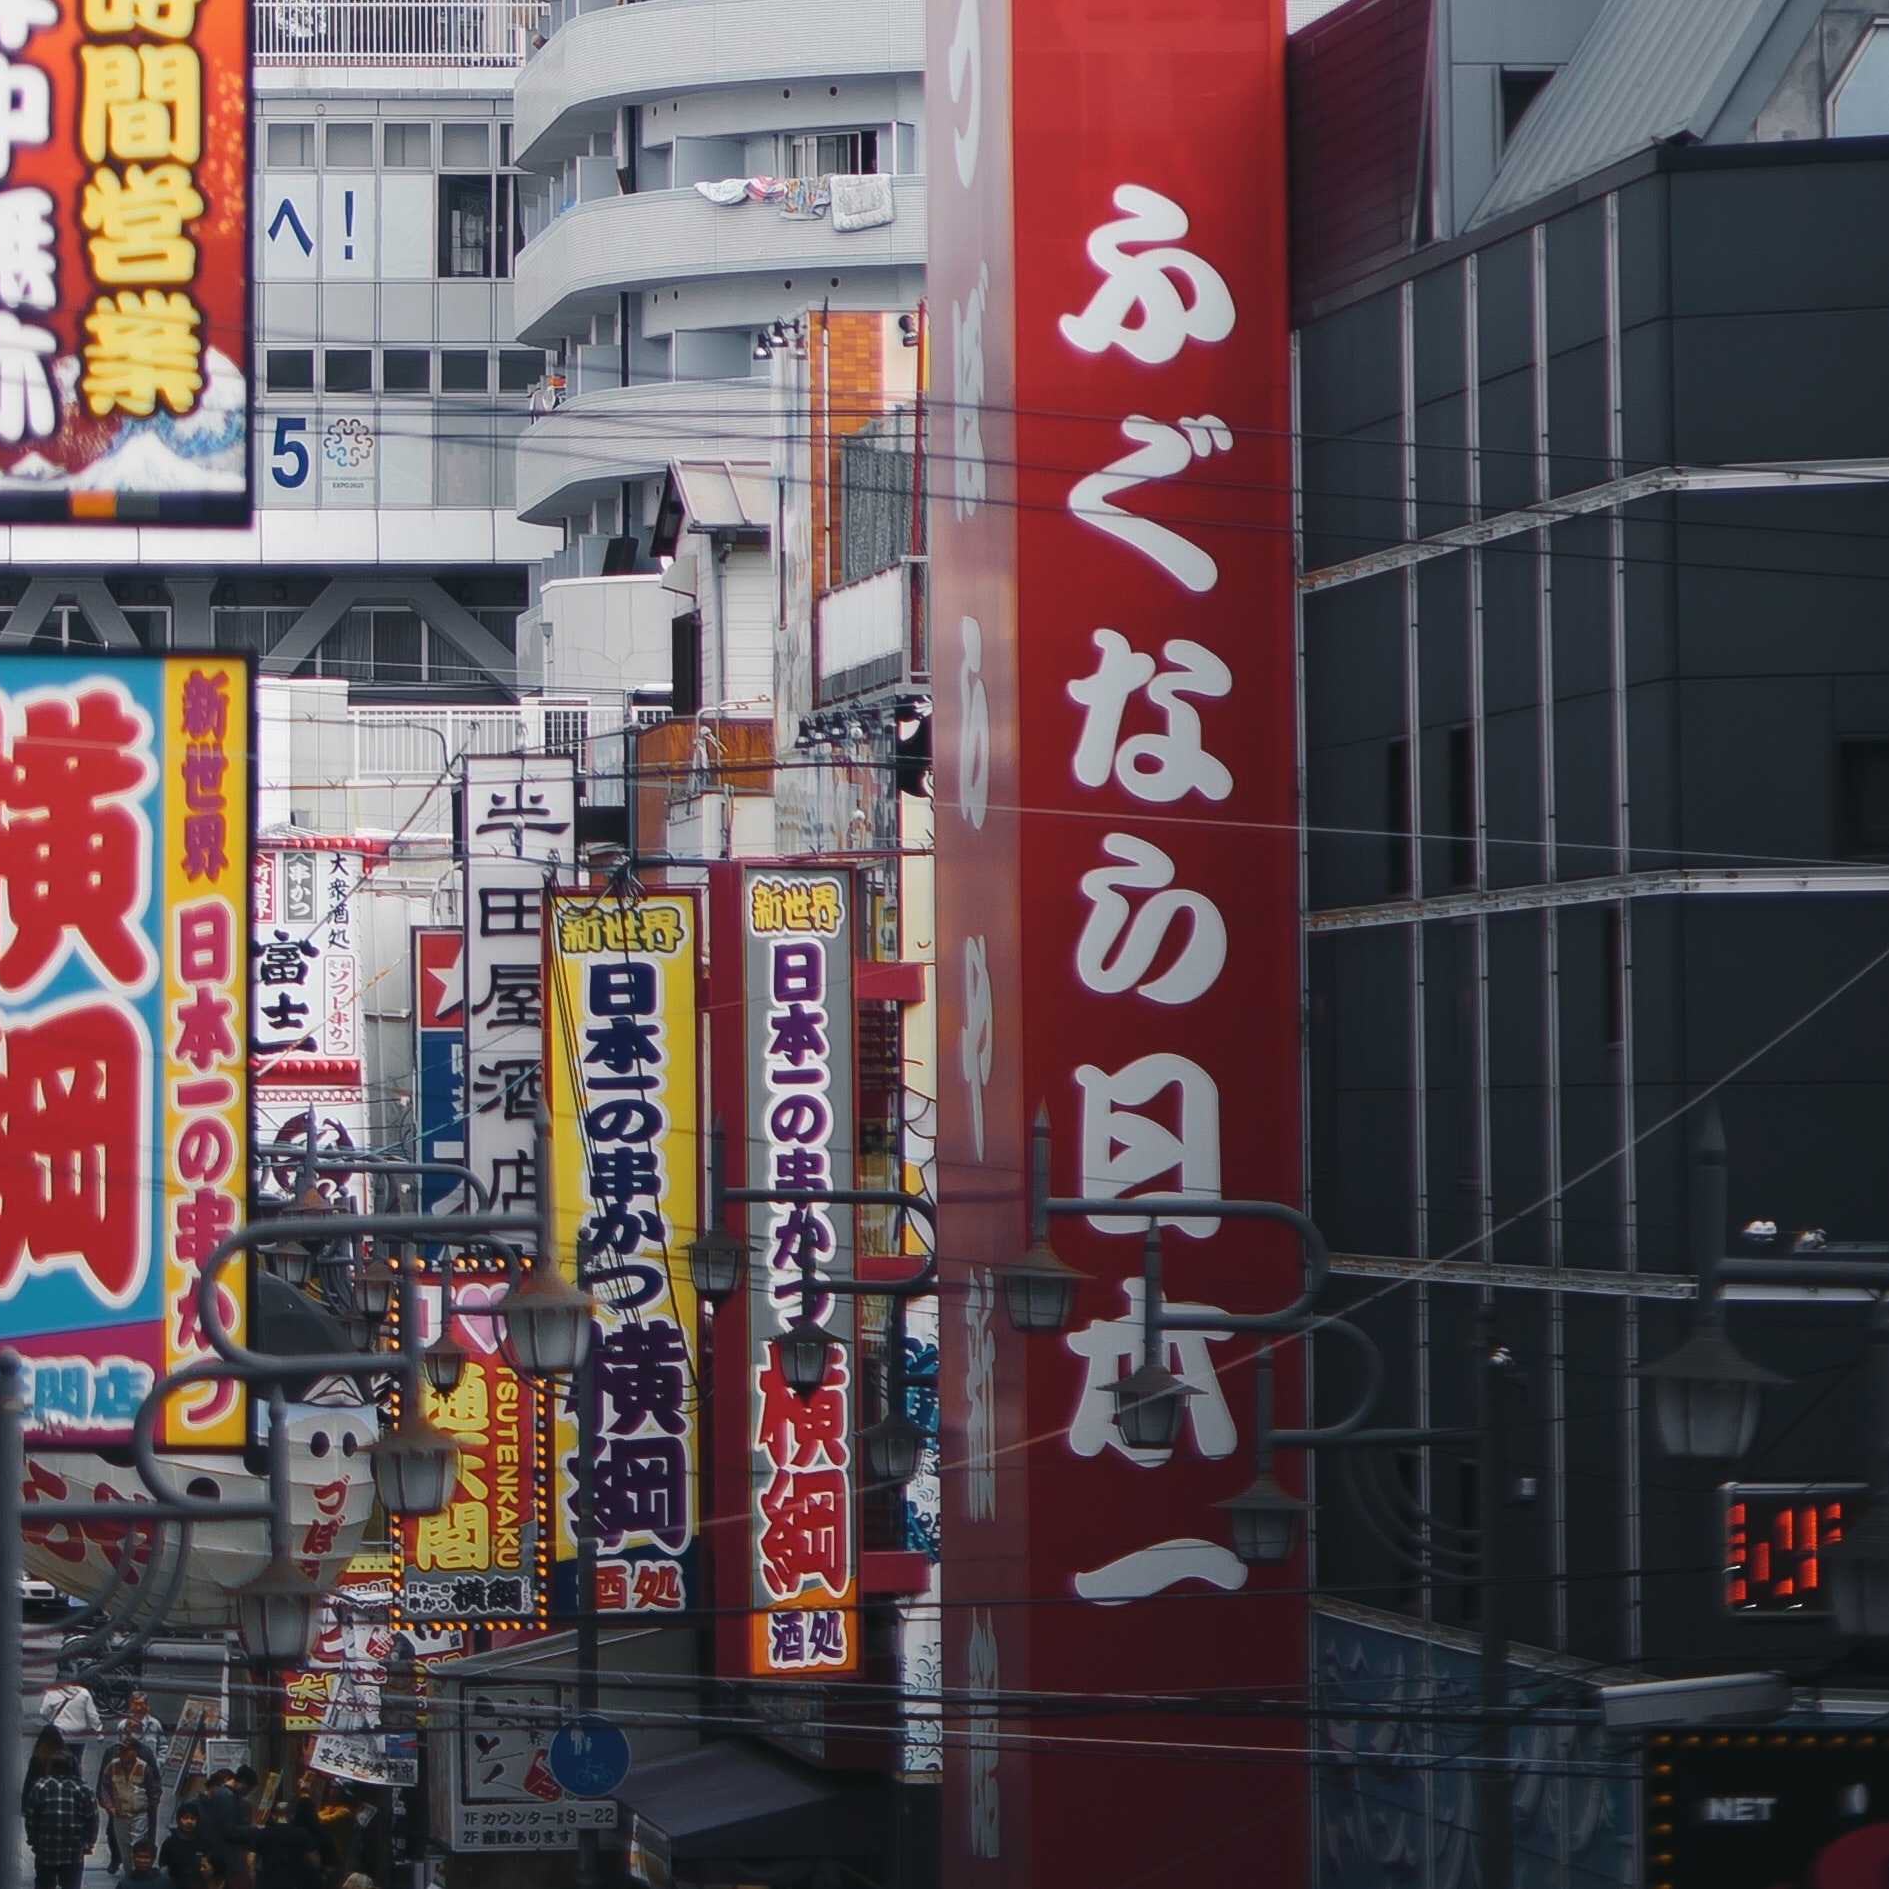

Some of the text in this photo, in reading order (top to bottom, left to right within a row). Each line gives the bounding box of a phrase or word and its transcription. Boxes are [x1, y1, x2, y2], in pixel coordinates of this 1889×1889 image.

[180, 669, 229, 882] 新世界
[288, 861, 312, 917] 串かつ
[561, 908, 684, 952] 新世界
[752, 883, 841, 931] 新世界
[176, 908, 239, 1422] 日本一の串かつ
[585, 963, 665, 1311] 日本一の串かつ
[767, 943, 830, 1329] 日本一の串かつ
[495, 1366, 521, 1568] TSUTENKAKU
[760, 1343, 850, 1595] 横綱
[771, 1611, 844, 1662] 酒処
